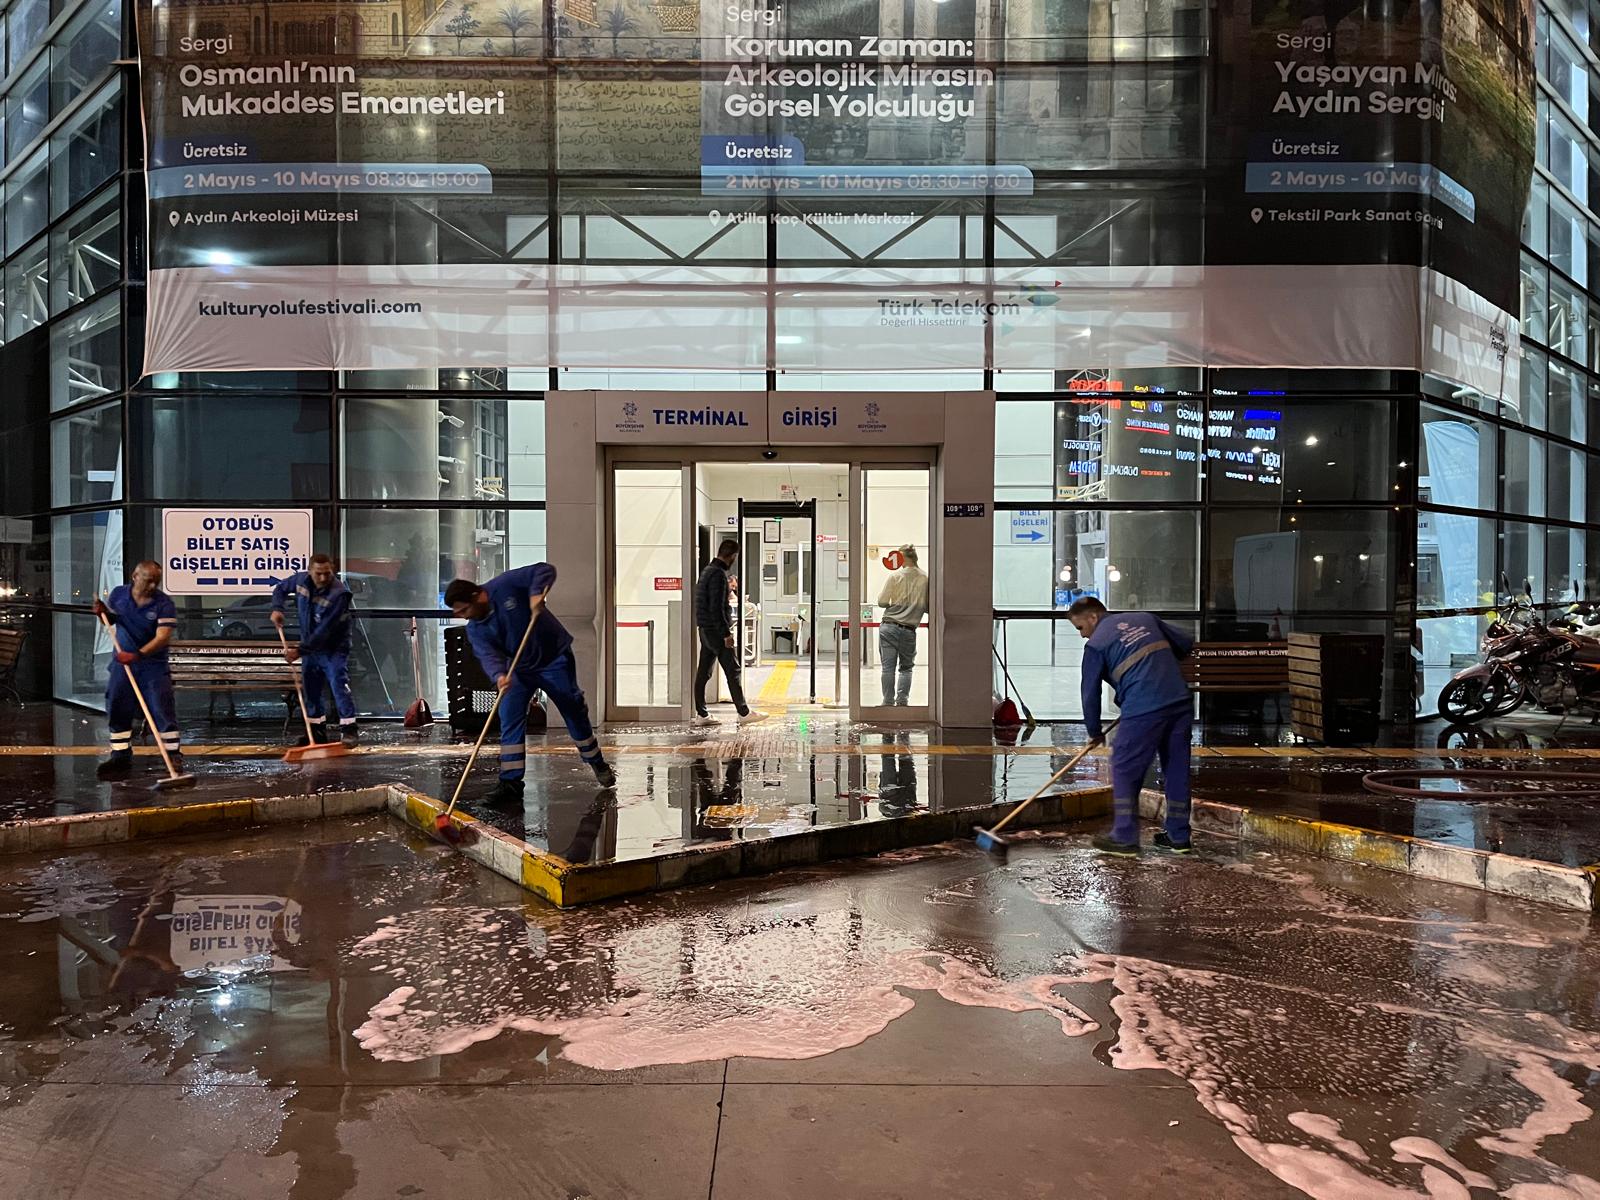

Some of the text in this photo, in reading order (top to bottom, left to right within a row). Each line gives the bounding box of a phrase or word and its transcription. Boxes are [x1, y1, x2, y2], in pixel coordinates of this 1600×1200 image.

[726, 4, 782, 24] Sergi
[180, 35, 233, 54] Sergi
[724, 36, 974, 56] Korunan Zaman:
[1276, 33, 1331, 53] Sergi
[724, 64, 994, 92] Arkeolojik Mirasın
[1275, 61, 1406, 88] Yaşayan
[181, 90, 505, 117] Mukaddes Emanetleri
[724, 92, 975, 123] Görsel Yolculuğu
[1272, 91, 1444, 123] Aydın Sergisi
[183, 143, 247, 159] Ücretsiz
[725, 143, 792, 160] Ücretsiz
[1272, 140, 1340, 155] Ücretsiz
[184, 174, 195, 189] 2
[199, 173, 256, 190] Mayıs
[273, 172, 295, 187] 10
[300, 171, 360, 190] Mayıs
[365, 172, 478, 187] 08.30-19.00
[726, 175, 737, 190] 2
[741, 174, 800, 192] Mayıs
[819, 174, 841, 190] 10
[846, 174, 902, 192] Mayıs
[907, 174, 1020, 190] 08.30-19.00
[1270, 172, 1282, 186] 2
[1286, 171, 1346, 188] Mayıs
[1364, 171, 1385, 186] 10
[184, 208, 359, 225] Aydın Arkeoloji Müzesi
[726, 212, 915, 226] Atilla Koç Kültür Merkezi
[1268, 210, 1321, 222] Tekstil
[1325, 210, 1361, 222] Park
[1365, 209, 1412, 222] Sanat
[199, 299, 422, 320] kulturyolufestivali.com
[878, 299, 1020, 316] Türk Telekom
[880, 318, 966, 328] Değerli Hissettirir
[652, 406, 837, 428] TERMİNAL GİRİŞİ
[202, 514, 274, 530] OTOBÜS
[1012, 517, 1048, 526] GİŞELERİ
[187, 534, 290, 554] BİLET SATIŞ
[170, 554, 306, 574] GİŞELERİ GİRİŞİ
[888, 553, 898, 568] 1
